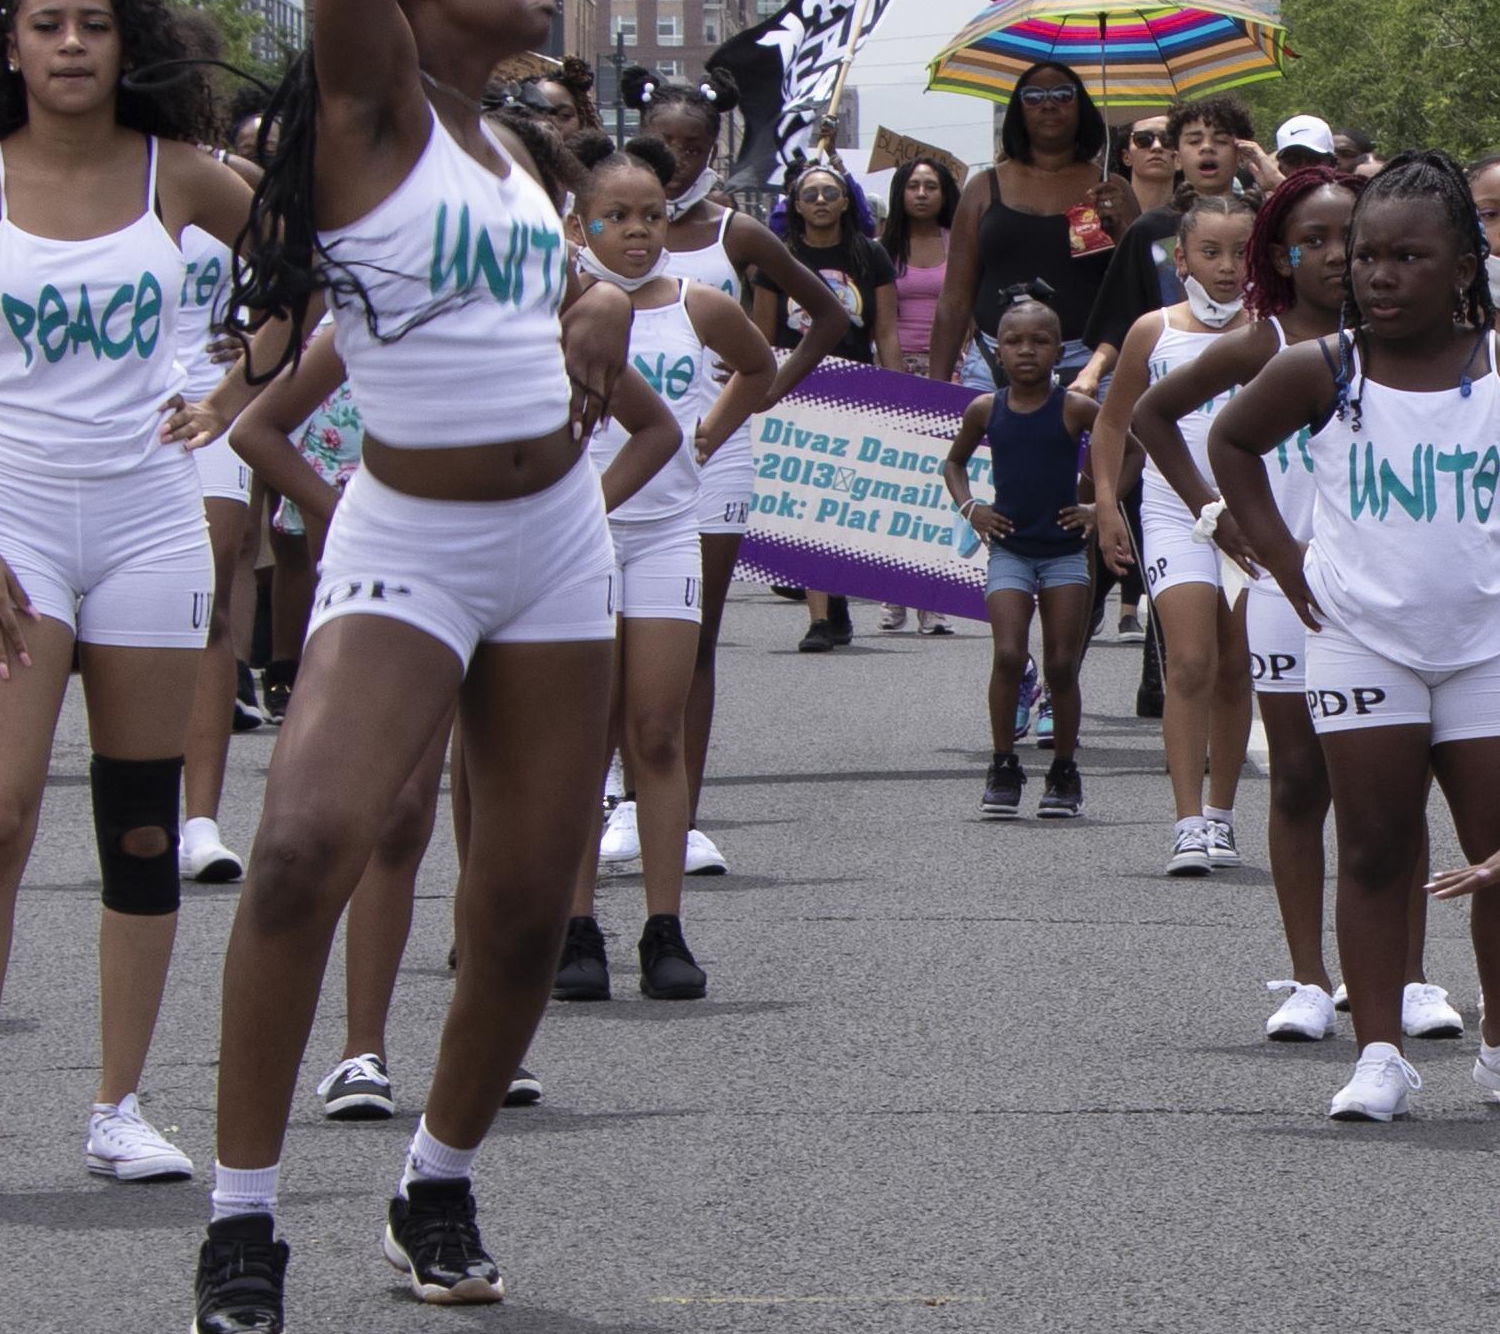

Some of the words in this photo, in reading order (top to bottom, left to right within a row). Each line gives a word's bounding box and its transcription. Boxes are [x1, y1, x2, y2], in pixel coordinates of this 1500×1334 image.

[760, 417, 850, 457] Divaz
[815, 497, 881, 533] Plat
[887, 512, 953, 547] Diva
[1308, 687, 1386, 719] PDP
